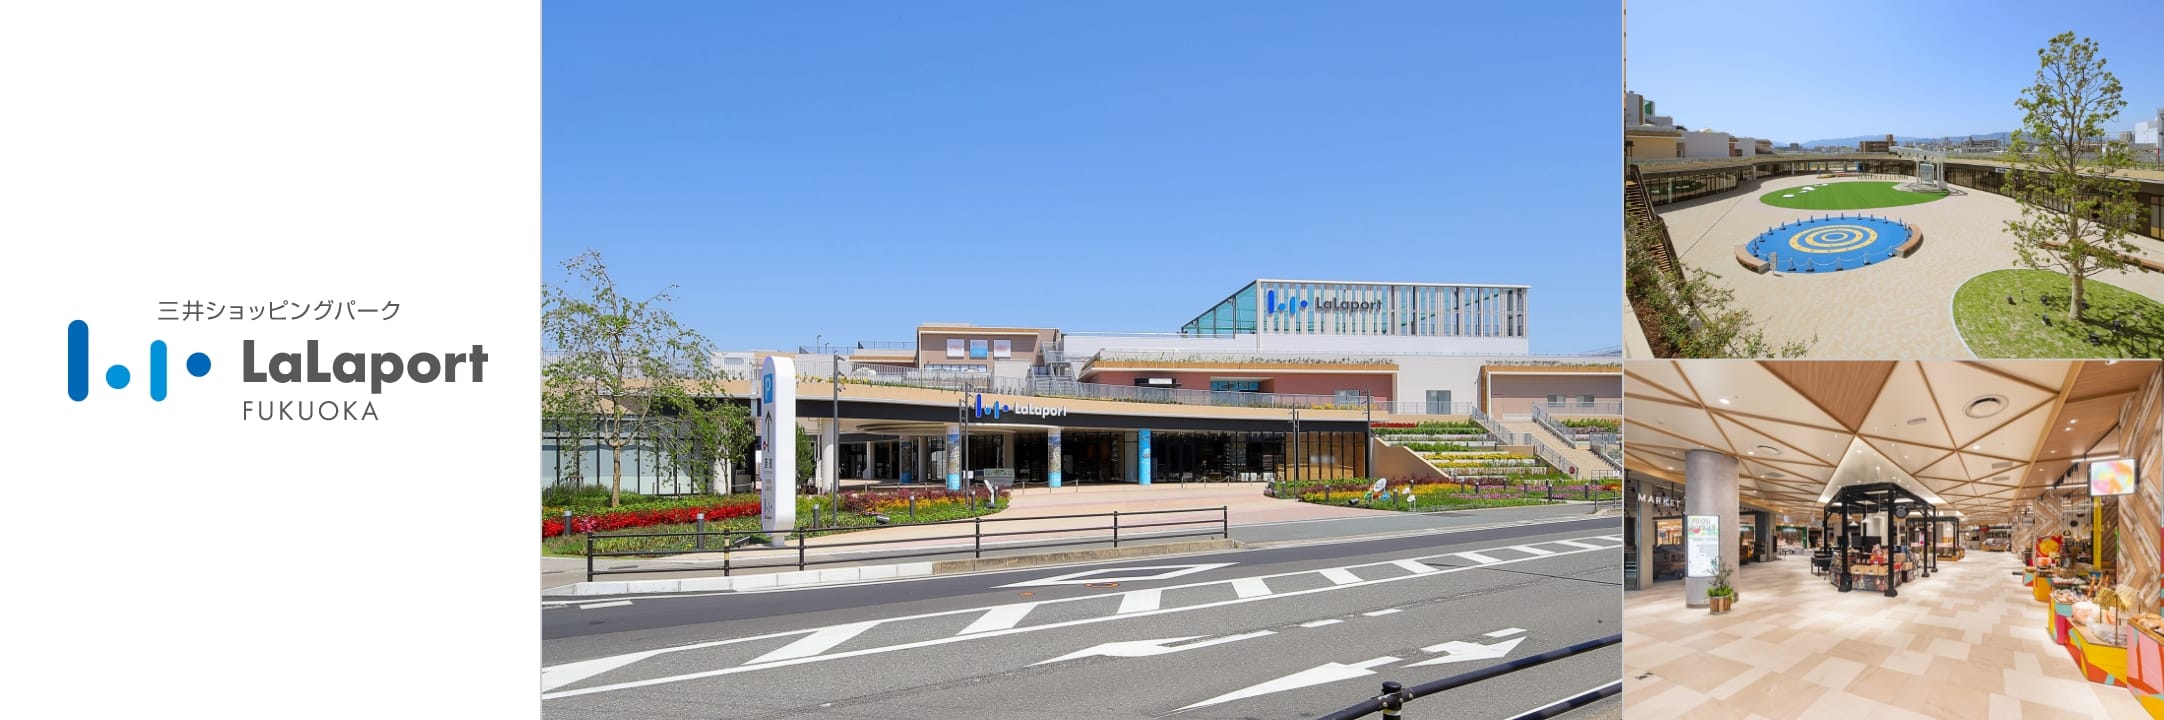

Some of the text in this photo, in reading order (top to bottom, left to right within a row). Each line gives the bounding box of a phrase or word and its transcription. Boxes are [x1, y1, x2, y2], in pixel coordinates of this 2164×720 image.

[1315, 297, 1382, 315] LaLaport
[1015, 402, 1067, 419] LaLaport
[1637, 493, 1681, 508] MARKET
